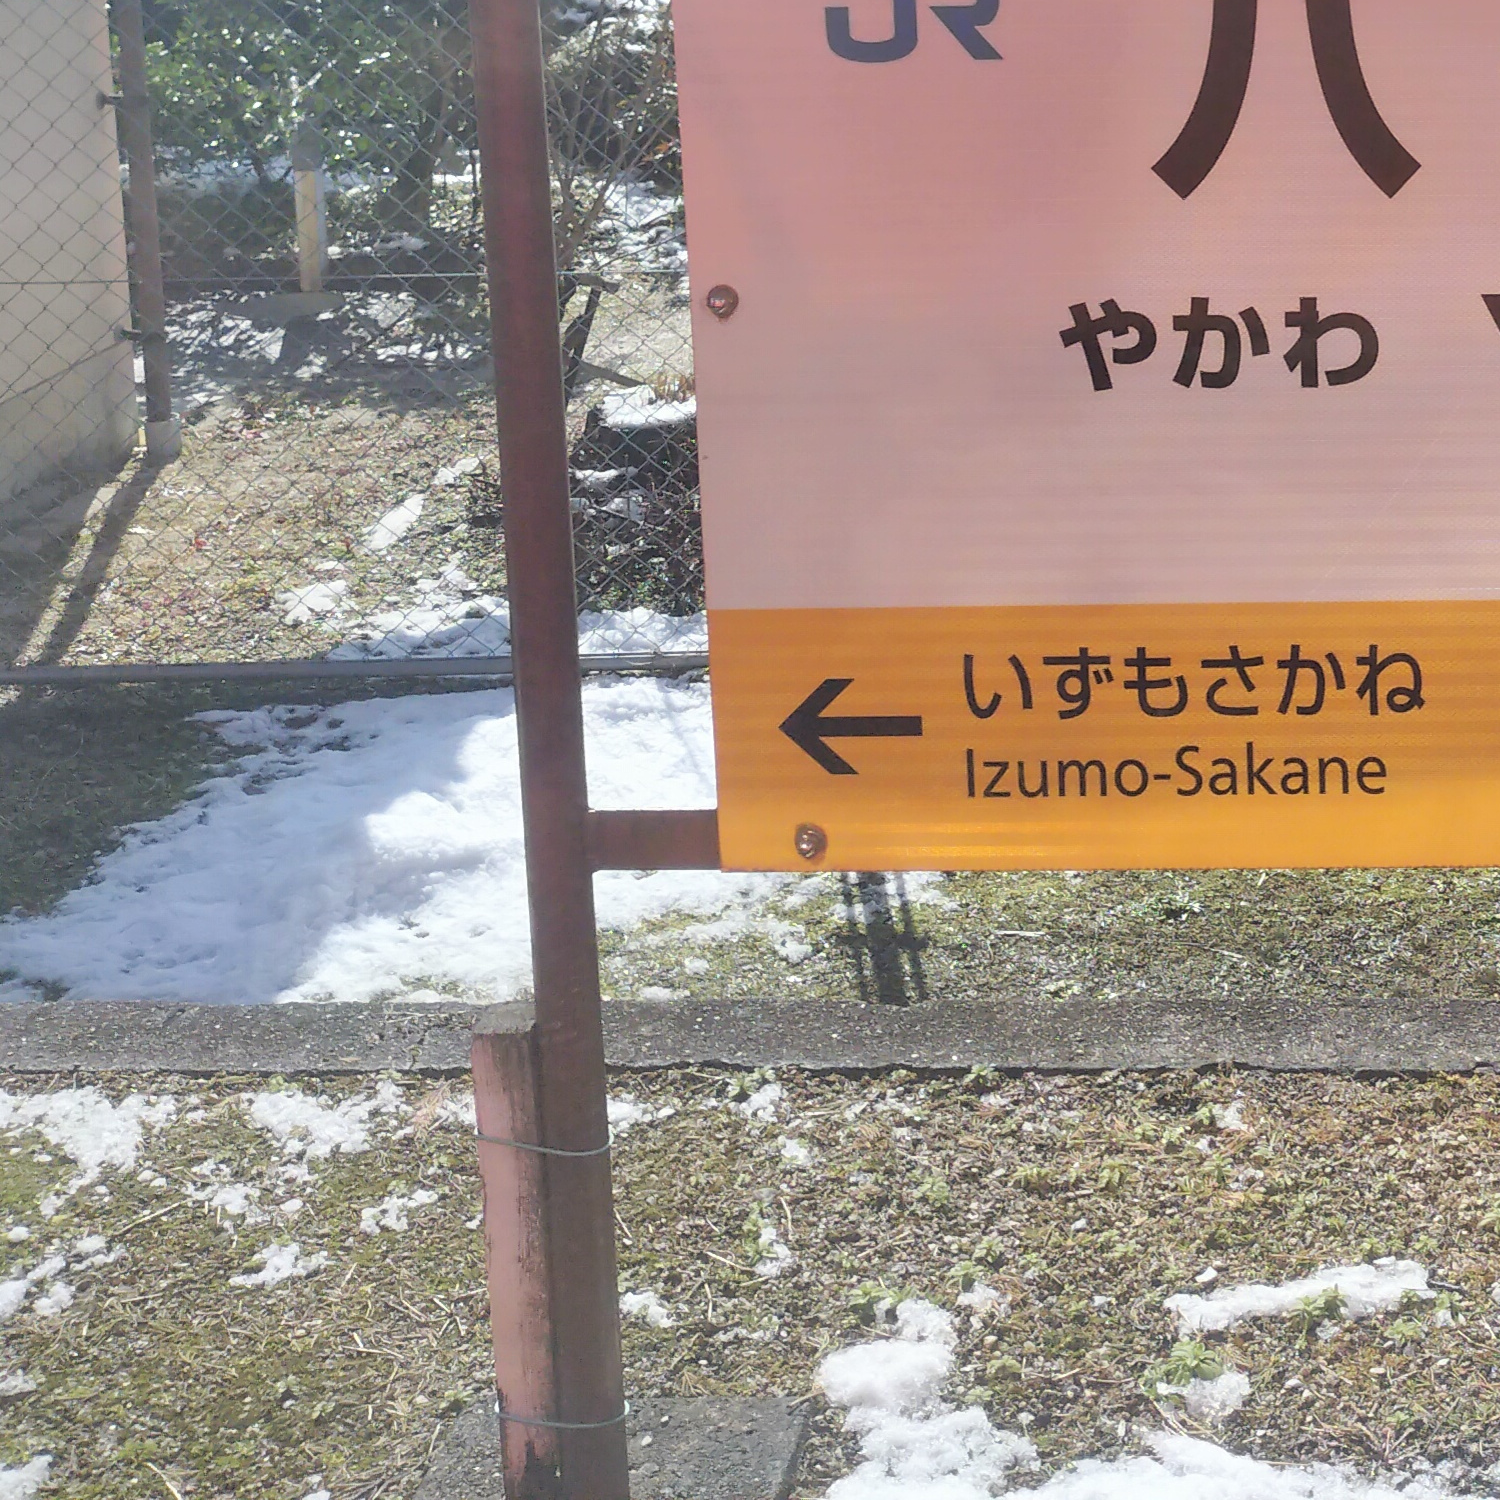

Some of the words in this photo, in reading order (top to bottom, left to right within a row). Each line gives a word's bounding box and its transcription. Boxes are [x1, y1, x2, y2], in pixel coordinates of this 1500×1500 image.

[1058, 296, 1379, 392] やかわ
[963, 644, 1426, 720] いずもさかね
[966, 741, 1388, 799] Izumo-Sakane
